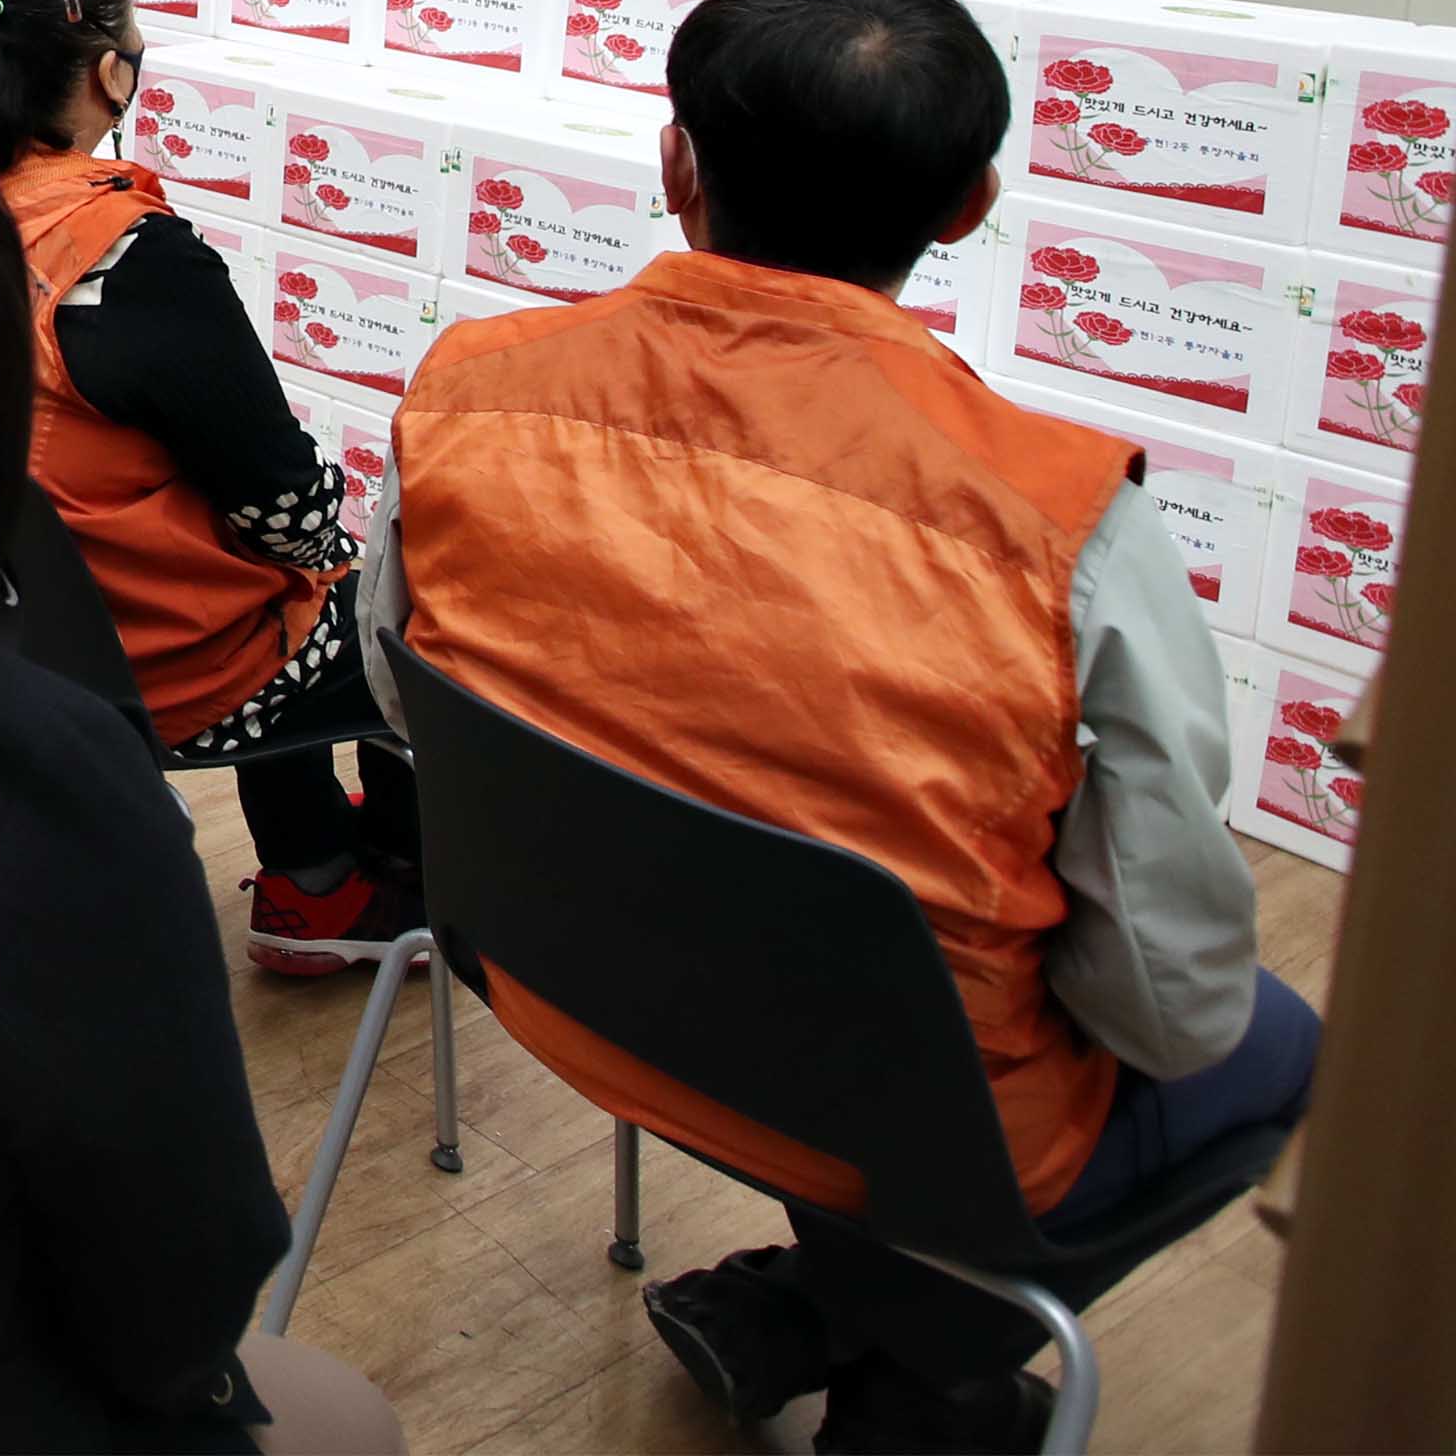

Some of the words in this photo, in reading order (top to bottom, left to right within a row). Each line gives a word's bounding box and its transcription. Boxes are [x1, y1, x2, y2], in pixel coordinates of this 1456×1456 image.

[1084, 96, 1126, 114] 맛있게
[1131, 104, 1176, 122] 드시고
[1070, 284, 1111, 303] 맛있게
[1118, 296, 1161, 314] 드시고
